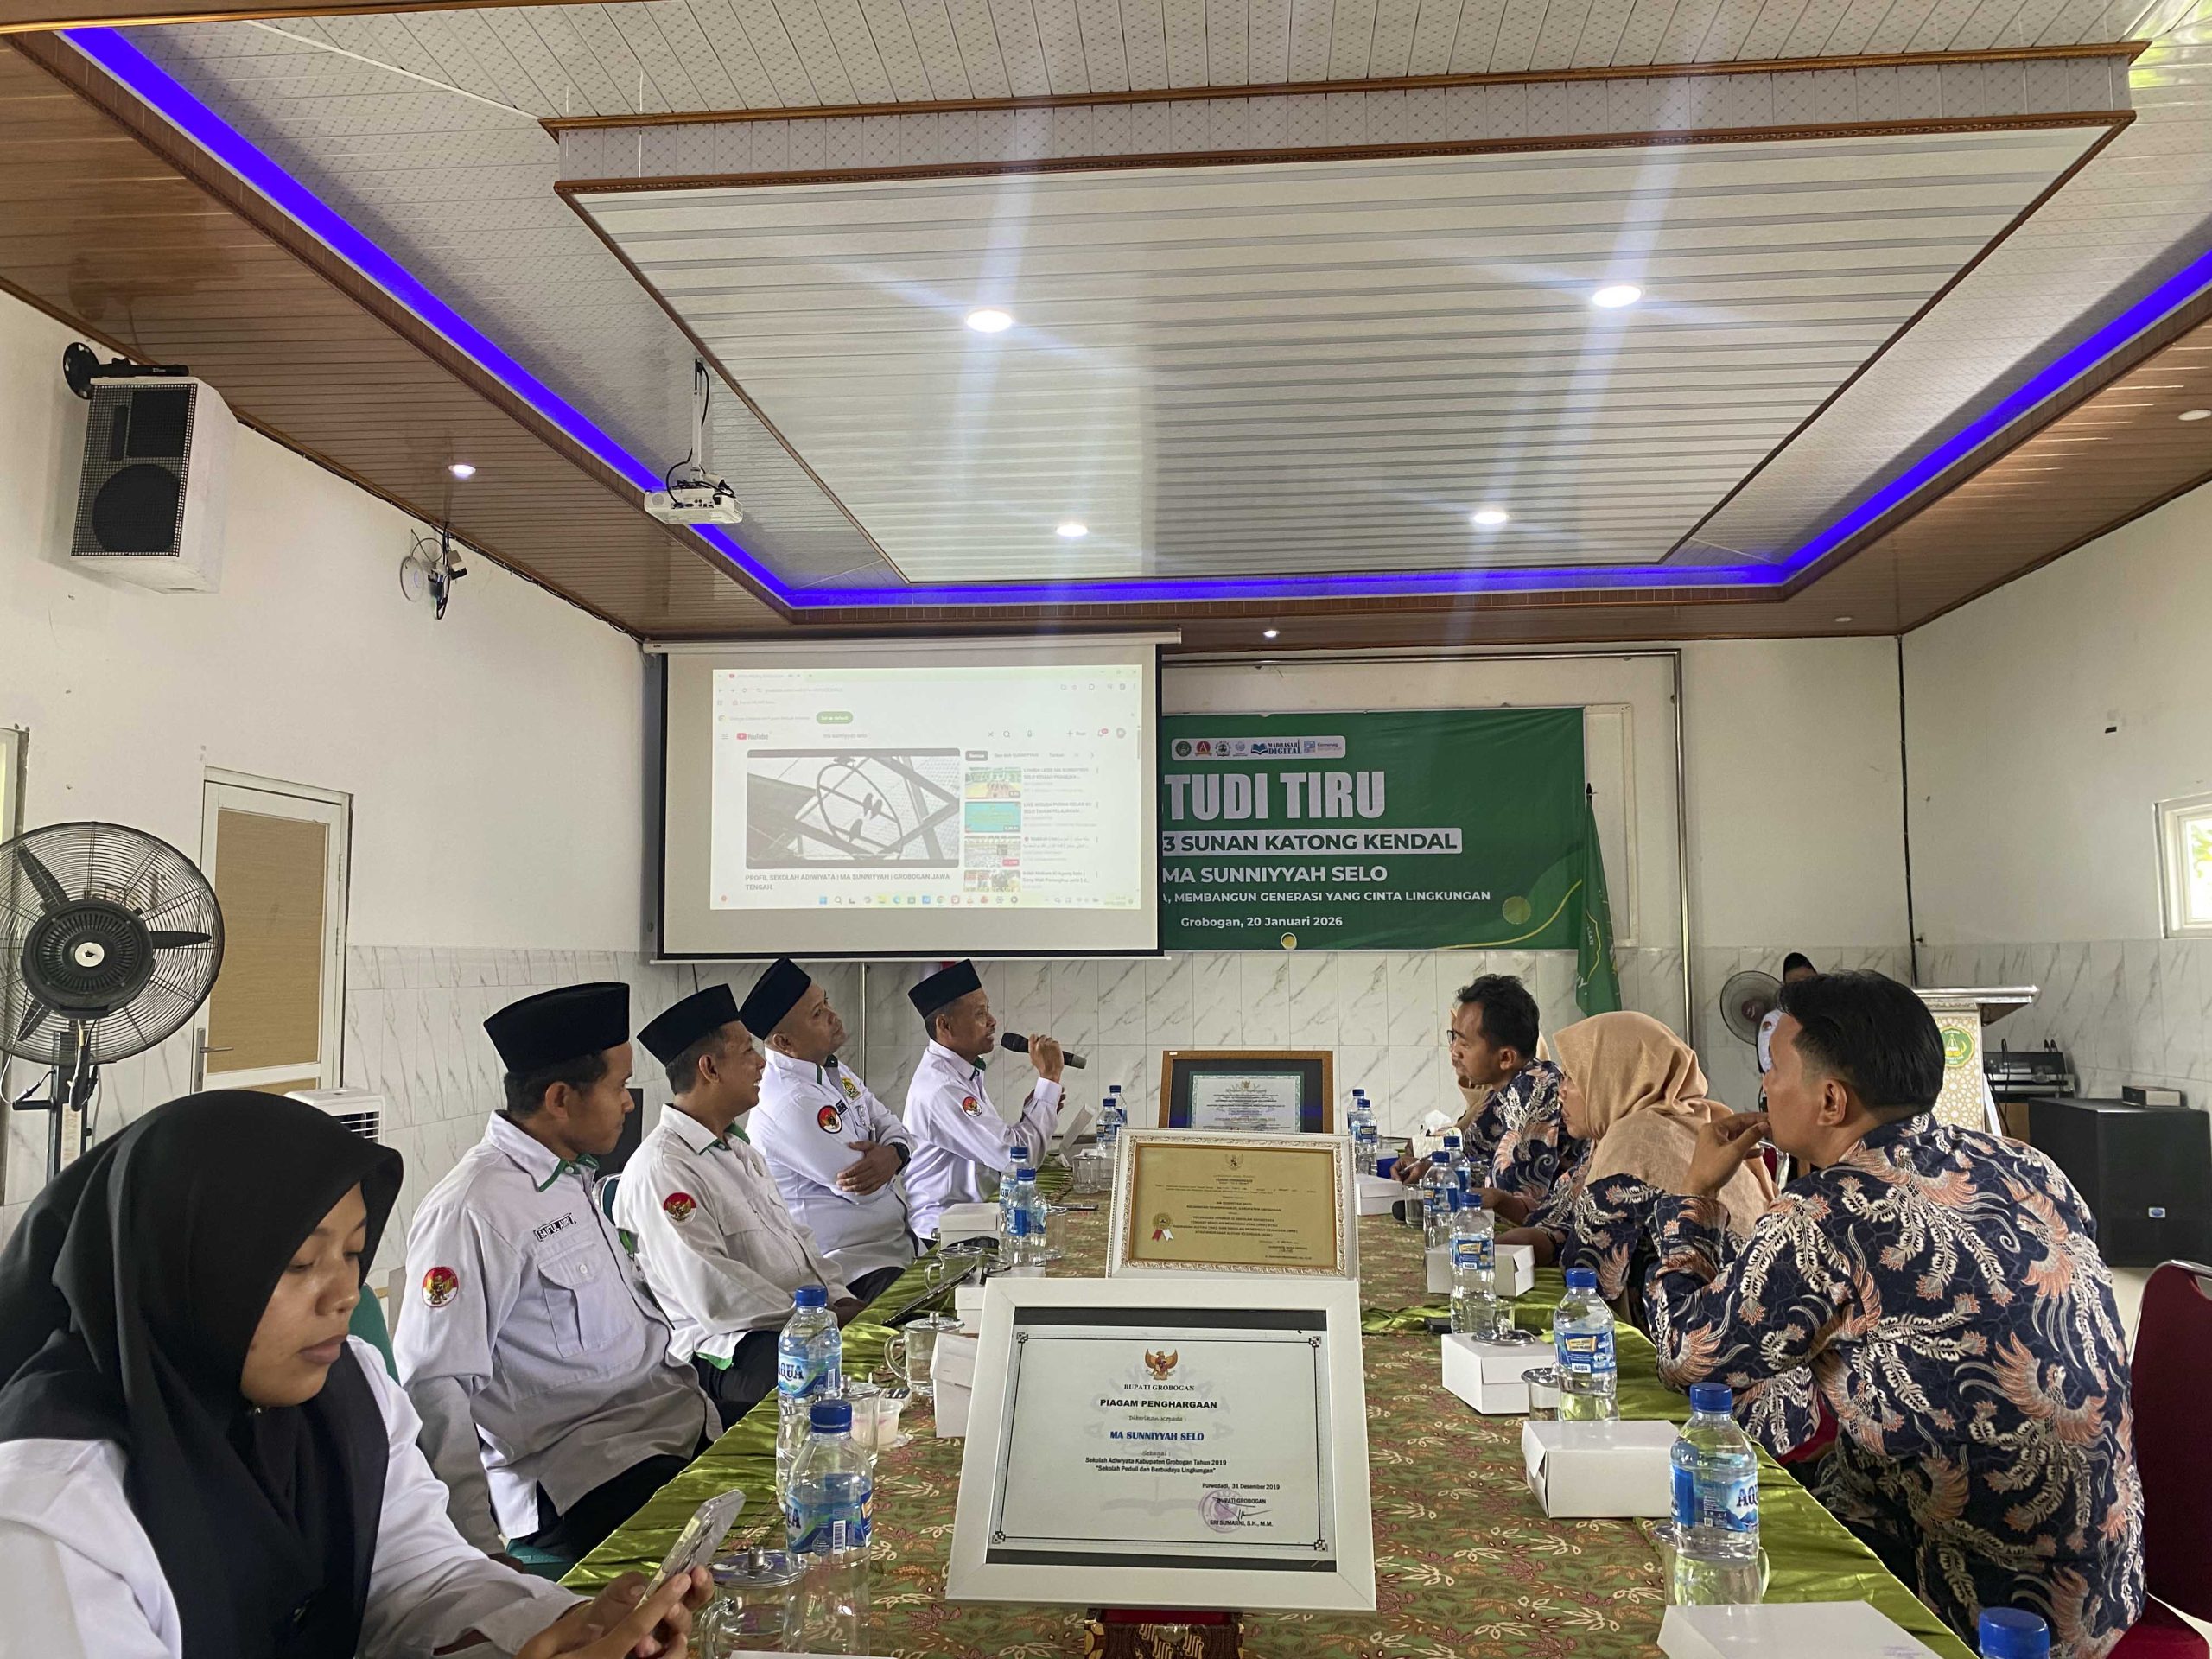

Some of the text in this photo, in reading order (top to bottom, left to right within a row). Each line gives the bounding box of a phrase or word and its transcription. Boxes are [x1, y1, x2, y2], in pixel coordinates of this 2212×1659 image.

[1268, 743, 1302, 755] DIGITAL
[1162, 771, 1386, 821] TUDI TIRU
[1163, 832, 1457, 852] 3 SUNAN KATONG KENDAL
[1162, 865, 1388, 883] MA SUNNIYYAH SELO
[1174, 893, 1257, 903] MEMBANGUN
[1260, 892, 1323, 902] GENERASI
[1325, 892, 1361, 902] YANG
[1363, 891, 1402, 901] CINTA
[1405, 891, 1491, 901] LINGKUNGAN
[1180, 916, 1343, 929] Grobogan, 20 Januari 2026
[1100, 1399, 1217, 1409] PIAGAM PENGHARGAAN
[1110, 1431, 1205, 1441] MA SUNNIYYAH SELO
[1135, 1458, 1166, 1466] Kabupaten
[1736, 1484, 1758, 1508] AQ
[785, 1503, 802, 1529] UA
